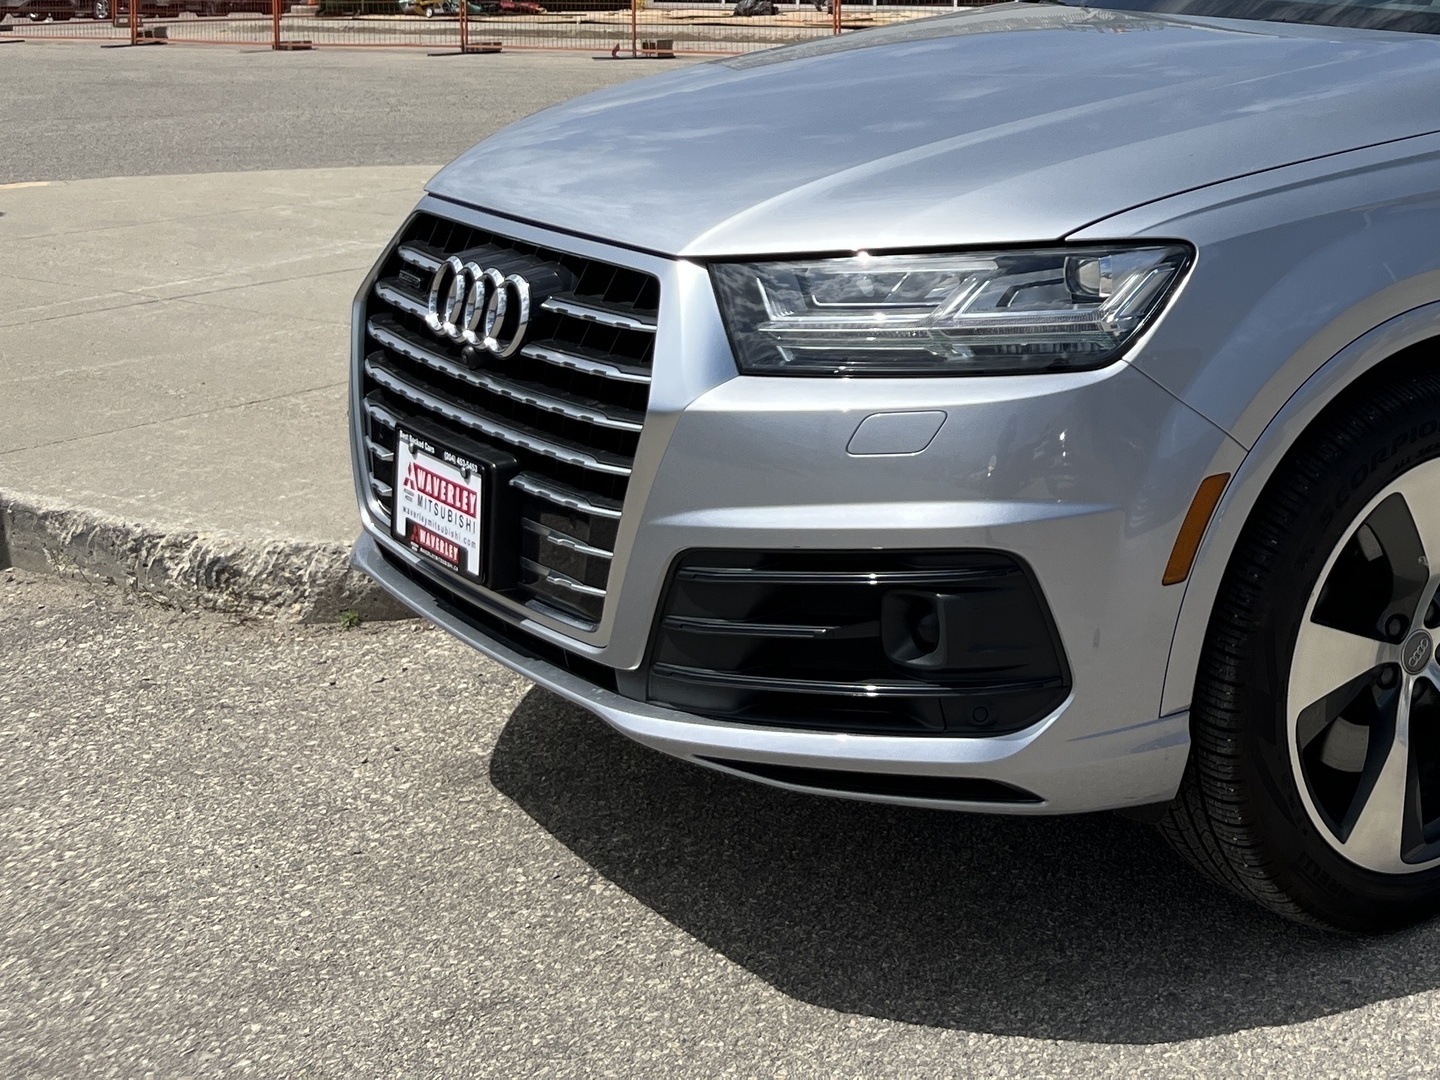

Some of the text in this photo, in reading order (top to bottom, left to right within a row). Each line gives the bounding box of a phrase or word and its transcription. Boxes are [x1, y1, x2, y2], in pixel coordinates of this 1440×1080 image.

[417, 467, 477, 516] WAVERLEY
[402, 505, 477, 549] waverleymitsubishi.com
[417, 493, 476, 535] MITSUBISHI
[419, 528, 459, 561] WAVERLEY
